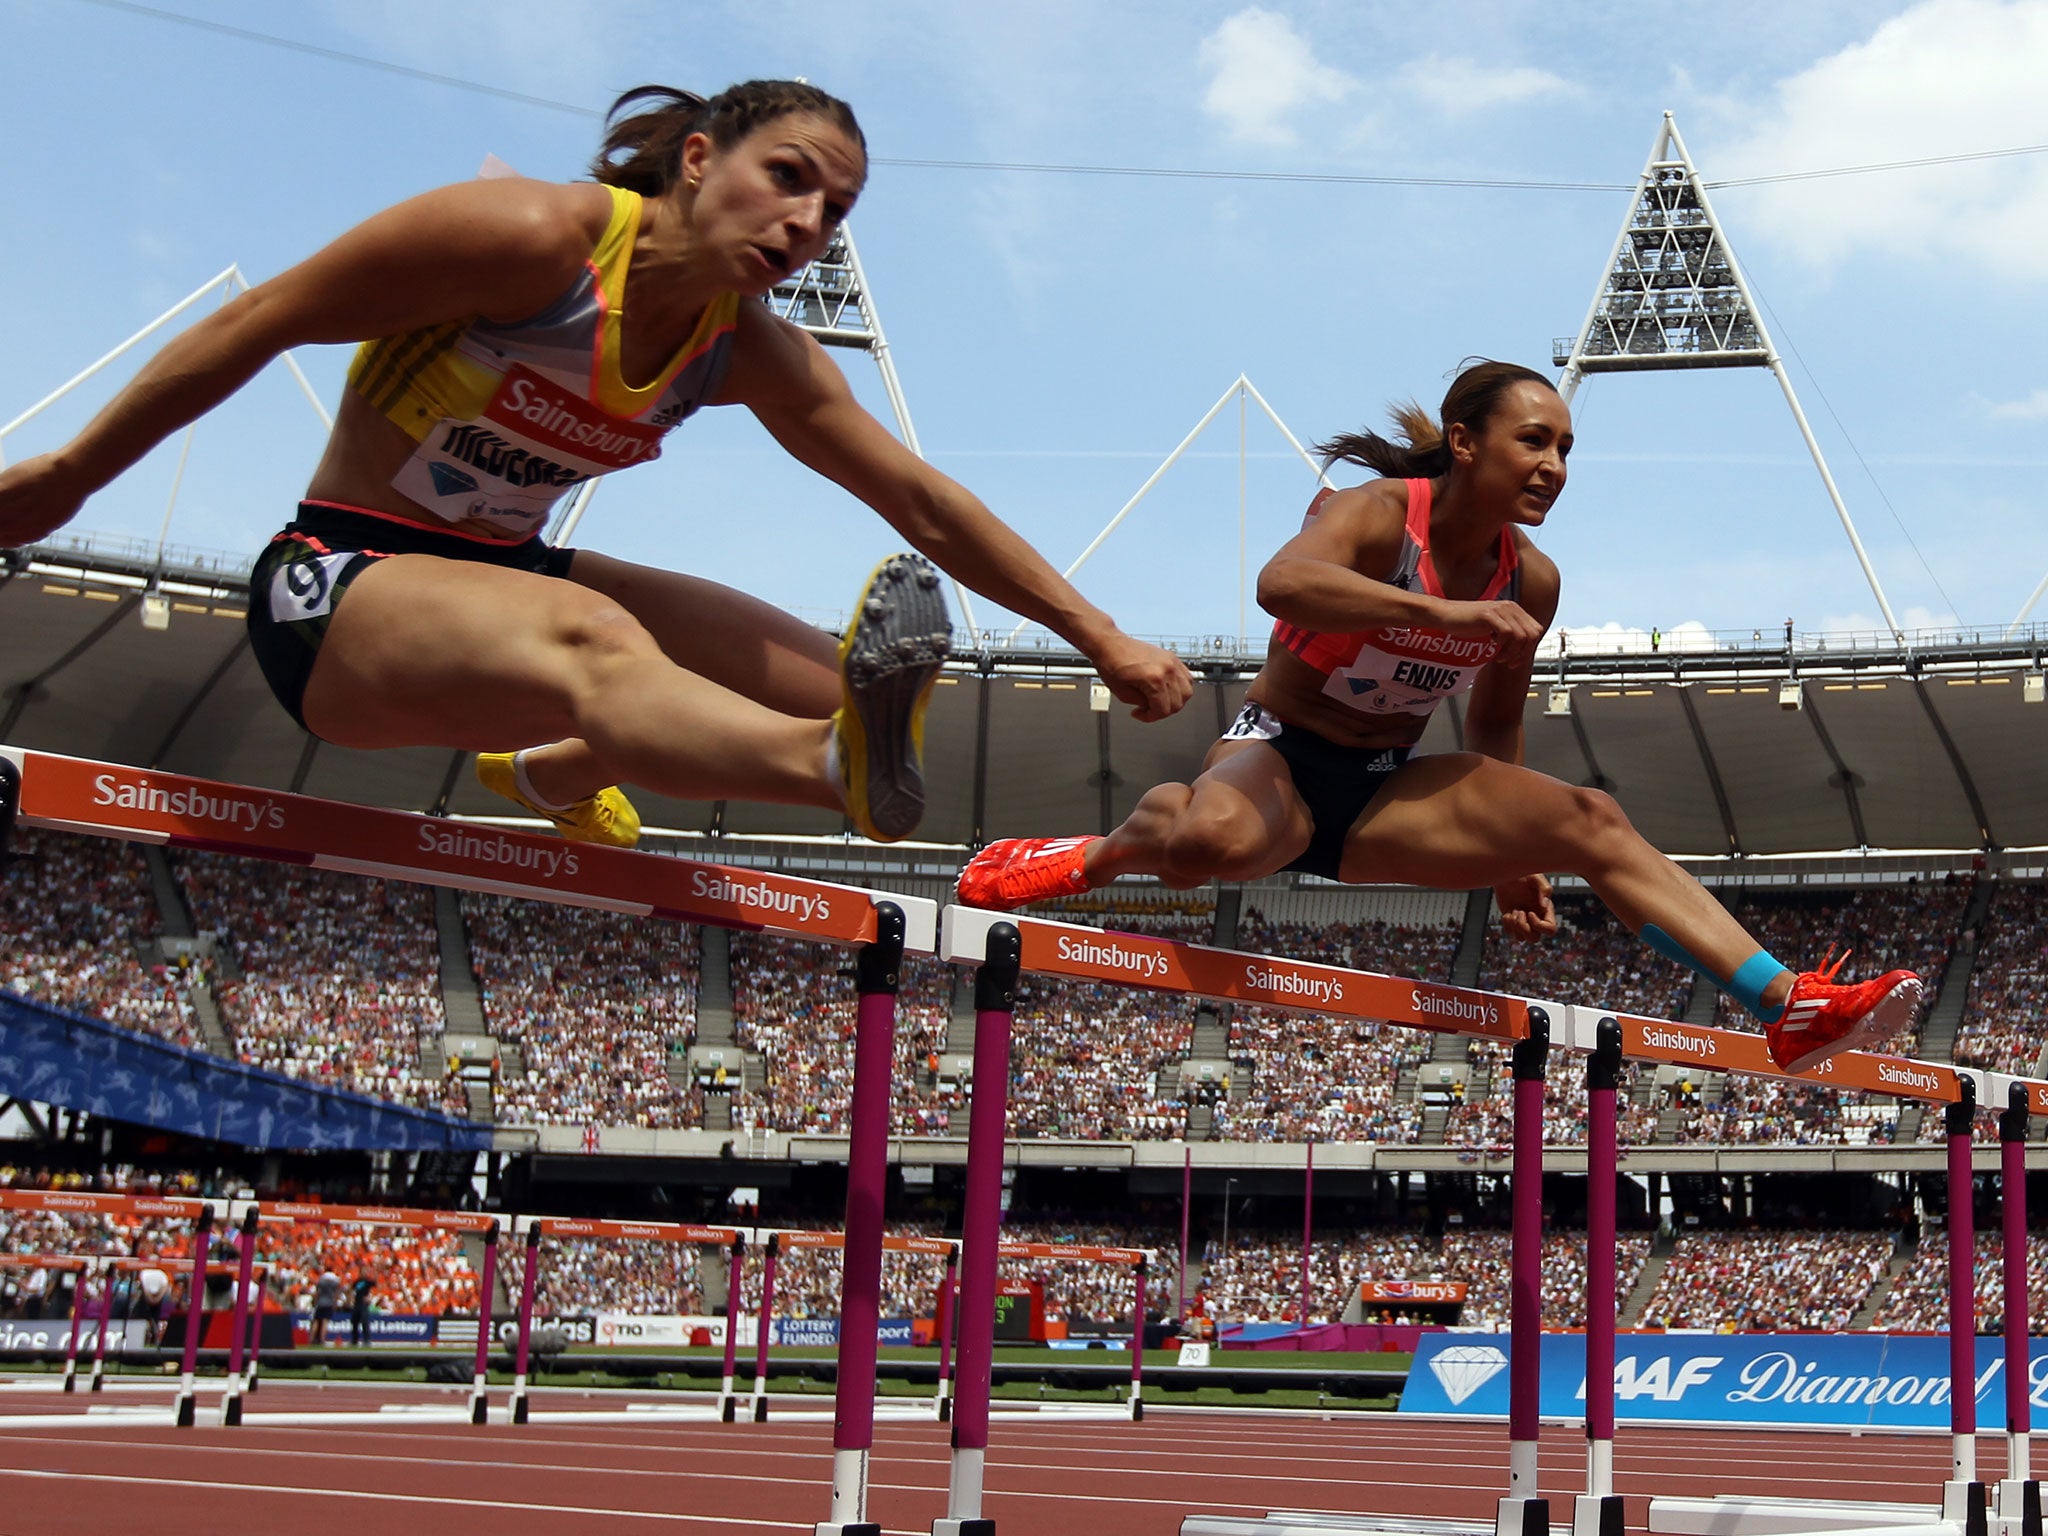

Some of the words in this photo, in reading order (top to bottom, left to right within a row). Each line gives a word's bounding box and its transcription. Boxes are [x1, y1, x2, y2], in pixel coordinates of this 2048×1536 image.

[287, 560, 329, 610] 9
[1392, 660, 1461, 691] ENNIS
[93, 774, 286, 831] Sainsbury's
[416, 824, 580, 878] Sainsbury's
[692, 870, 831, 922] Sainsbury's
[1057, 936, 1169, 977] Sainsbury's
[1245, 965, 1344, 1003] Sainsbury's
[1411, 989, 1499, 1026] Sainsbury's
[1642, 1026, 1717, 1058] Sainsbury's
[1878, 1062, 1940, 1092] Sainsbury's
[783, 1319, 836, 1332] LOTTERY
[783, 1332, 836, 1345] FUNDED
